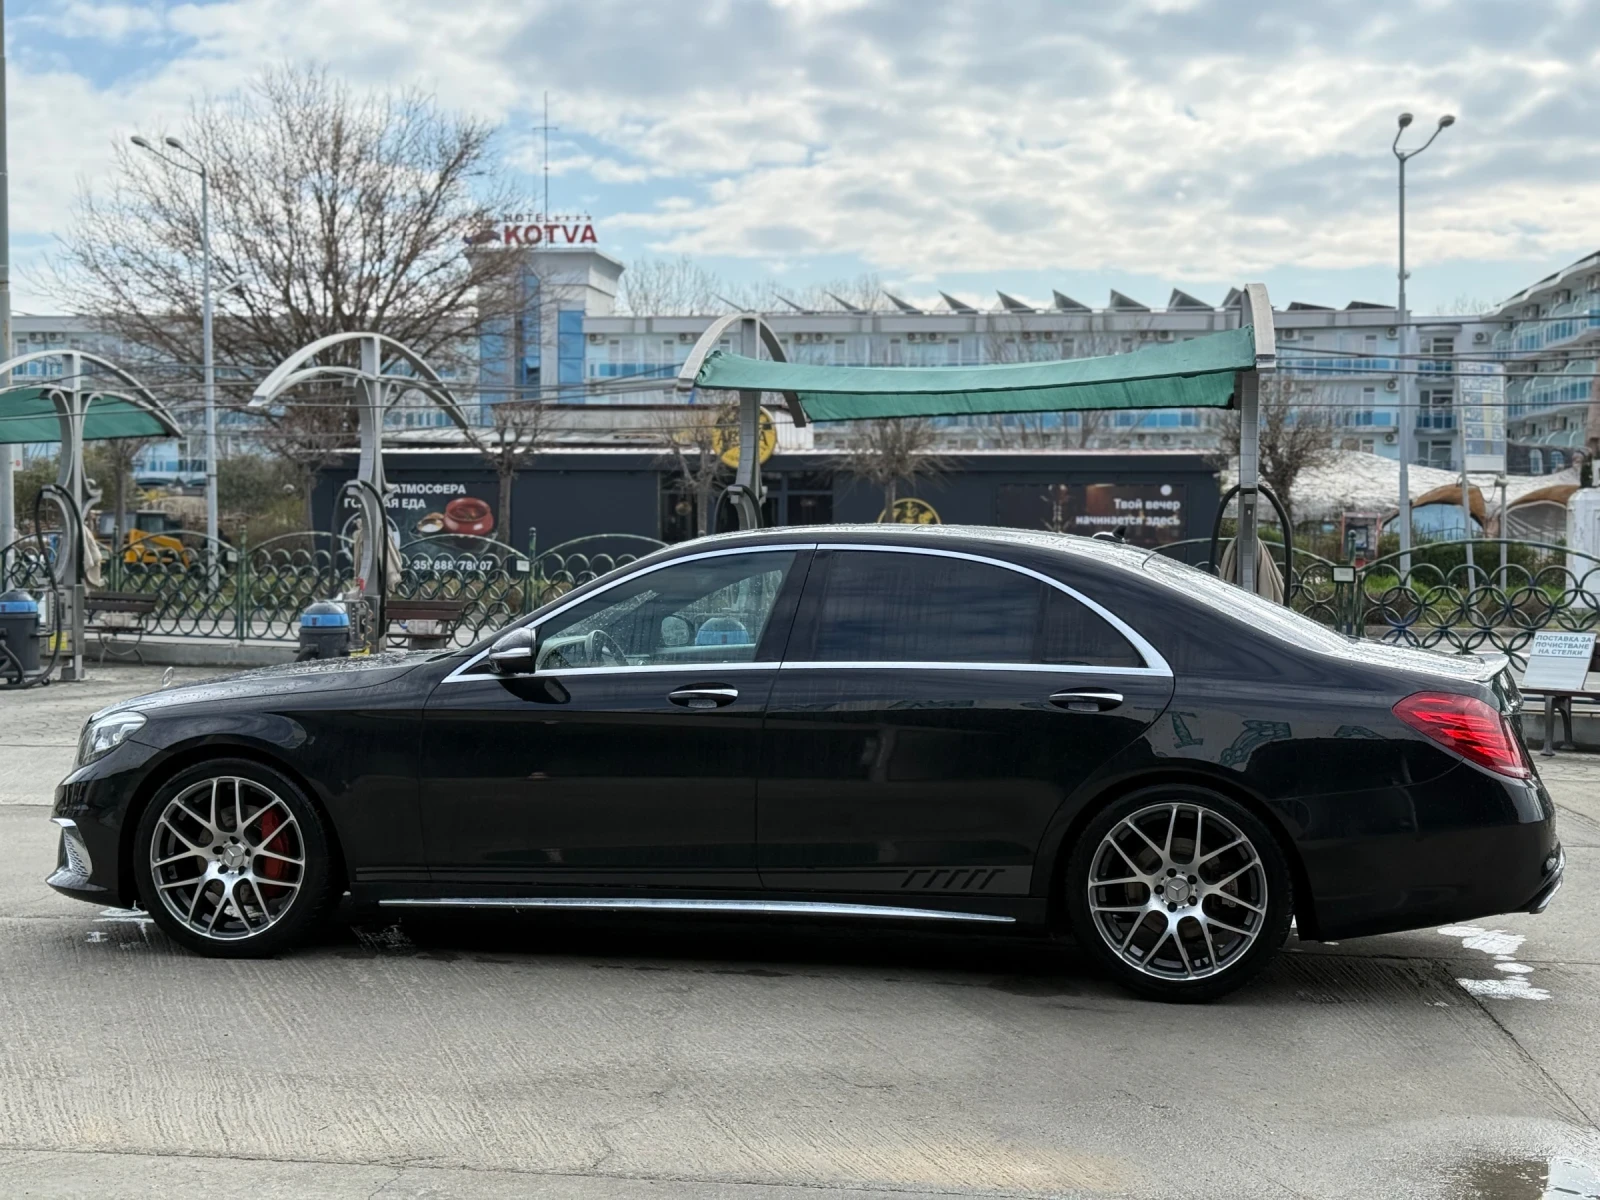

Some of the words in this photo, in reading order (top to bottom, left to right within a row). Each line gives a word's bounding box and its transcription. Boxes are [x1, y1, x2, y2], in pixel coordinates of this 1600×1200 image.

[504, 213, 552, 223] HOTEL
[504, 224, 598, 245] KOTVA
[401, 498, 427, 511] ЕДА
[1113, 498, 1143, 510] Твой
[1145, 501, 1181, 512] вечер
[1075, 515, 1143, 526] начинается
[1145, 515, 1181, 527] здесь
[1535, 641, 1590, 650] ПОЧИСТВАНЕ
